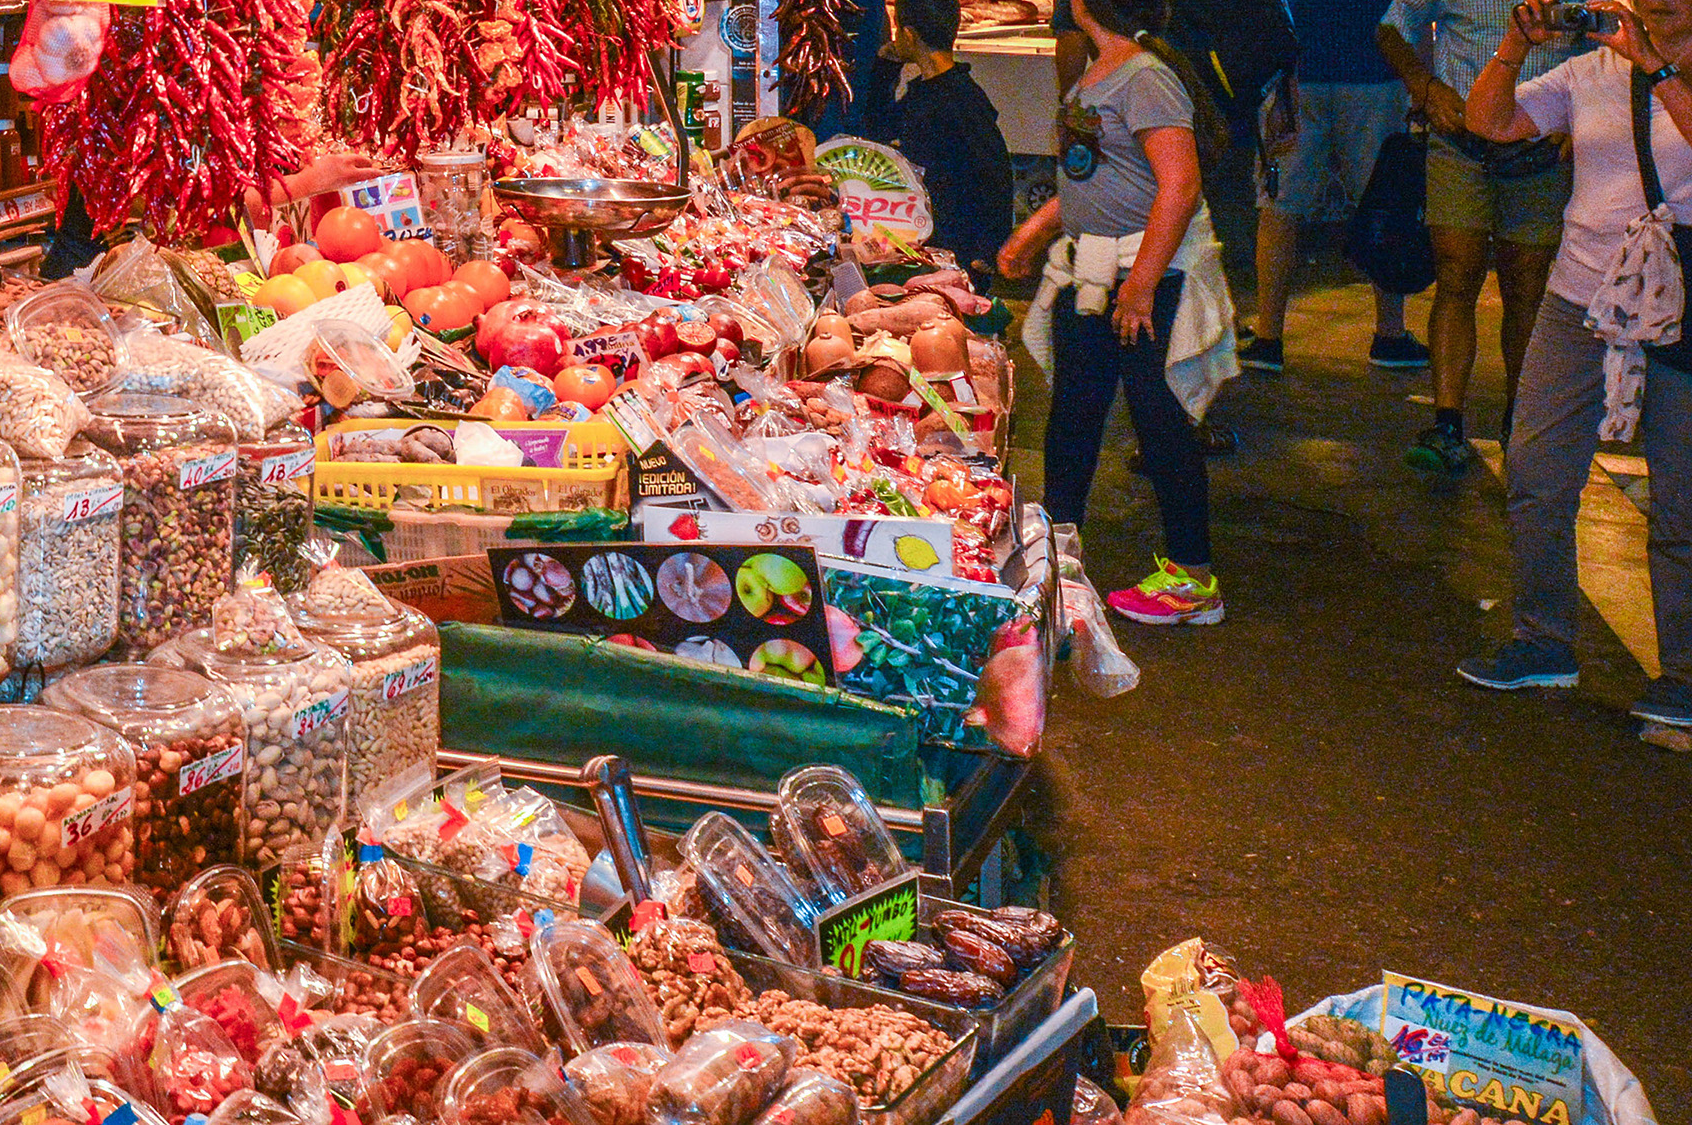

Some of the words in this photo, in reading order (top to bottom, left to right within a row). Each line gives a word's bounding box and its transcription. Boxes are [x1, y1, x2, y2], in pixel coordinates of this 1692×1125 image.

[844, 195, 919, 227] spri
[638, 469, 686, 485] ¡EDICIÓN
[640, 457, 668, 471] NUEVO
[638, 482, 697, 496] LIMITADA!
[65, 813, 94, 848] 36
[1422, 1005, 1469, 1048] Nuez
[1474, 1018, 1499, 1046] de
[1501, 1028, 1575, 1075] Málaga
[1416, 1067, 1571, 1125] ACANA
